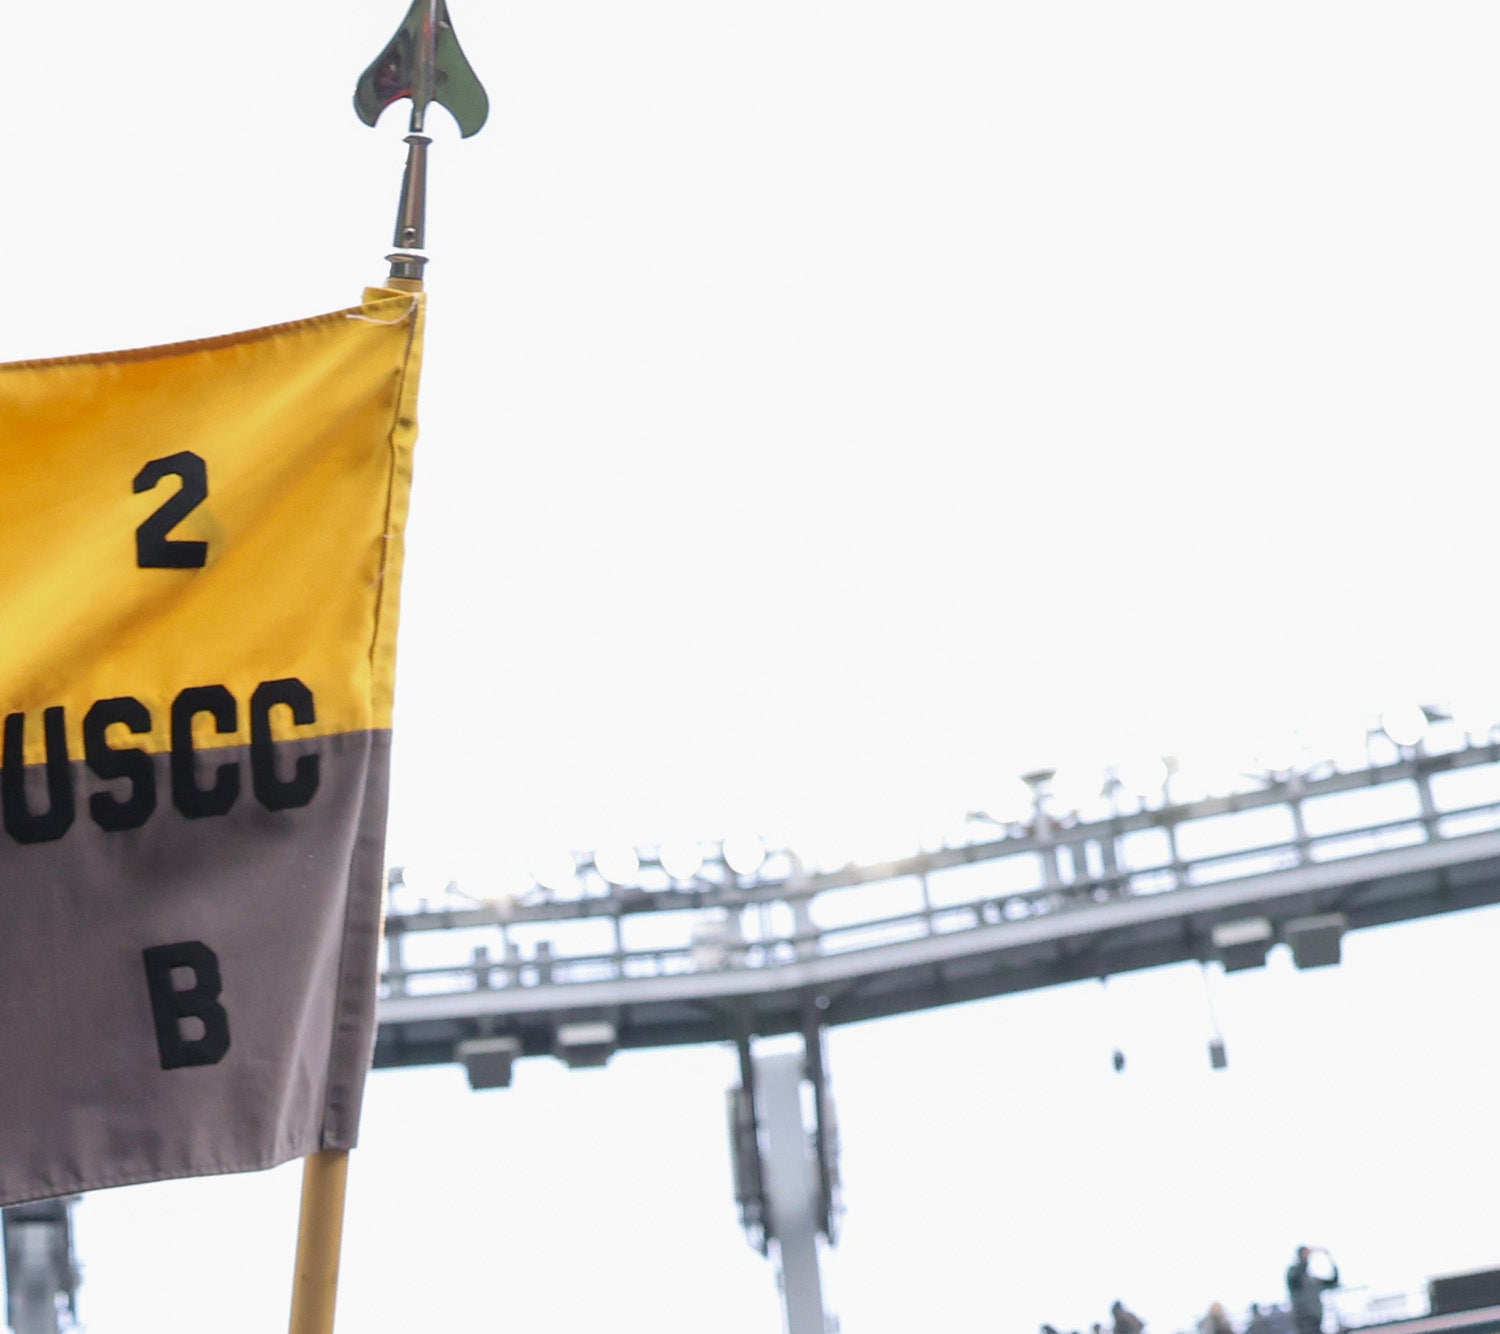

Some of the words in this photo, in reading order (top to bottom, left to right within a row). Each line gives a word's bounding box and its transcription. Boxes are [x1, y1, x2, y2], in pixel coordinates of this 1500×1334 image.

[131, 450, 209, 569] 2
[1, 677, 321, 845] USCC
[142, 940, 233, 1071] B
